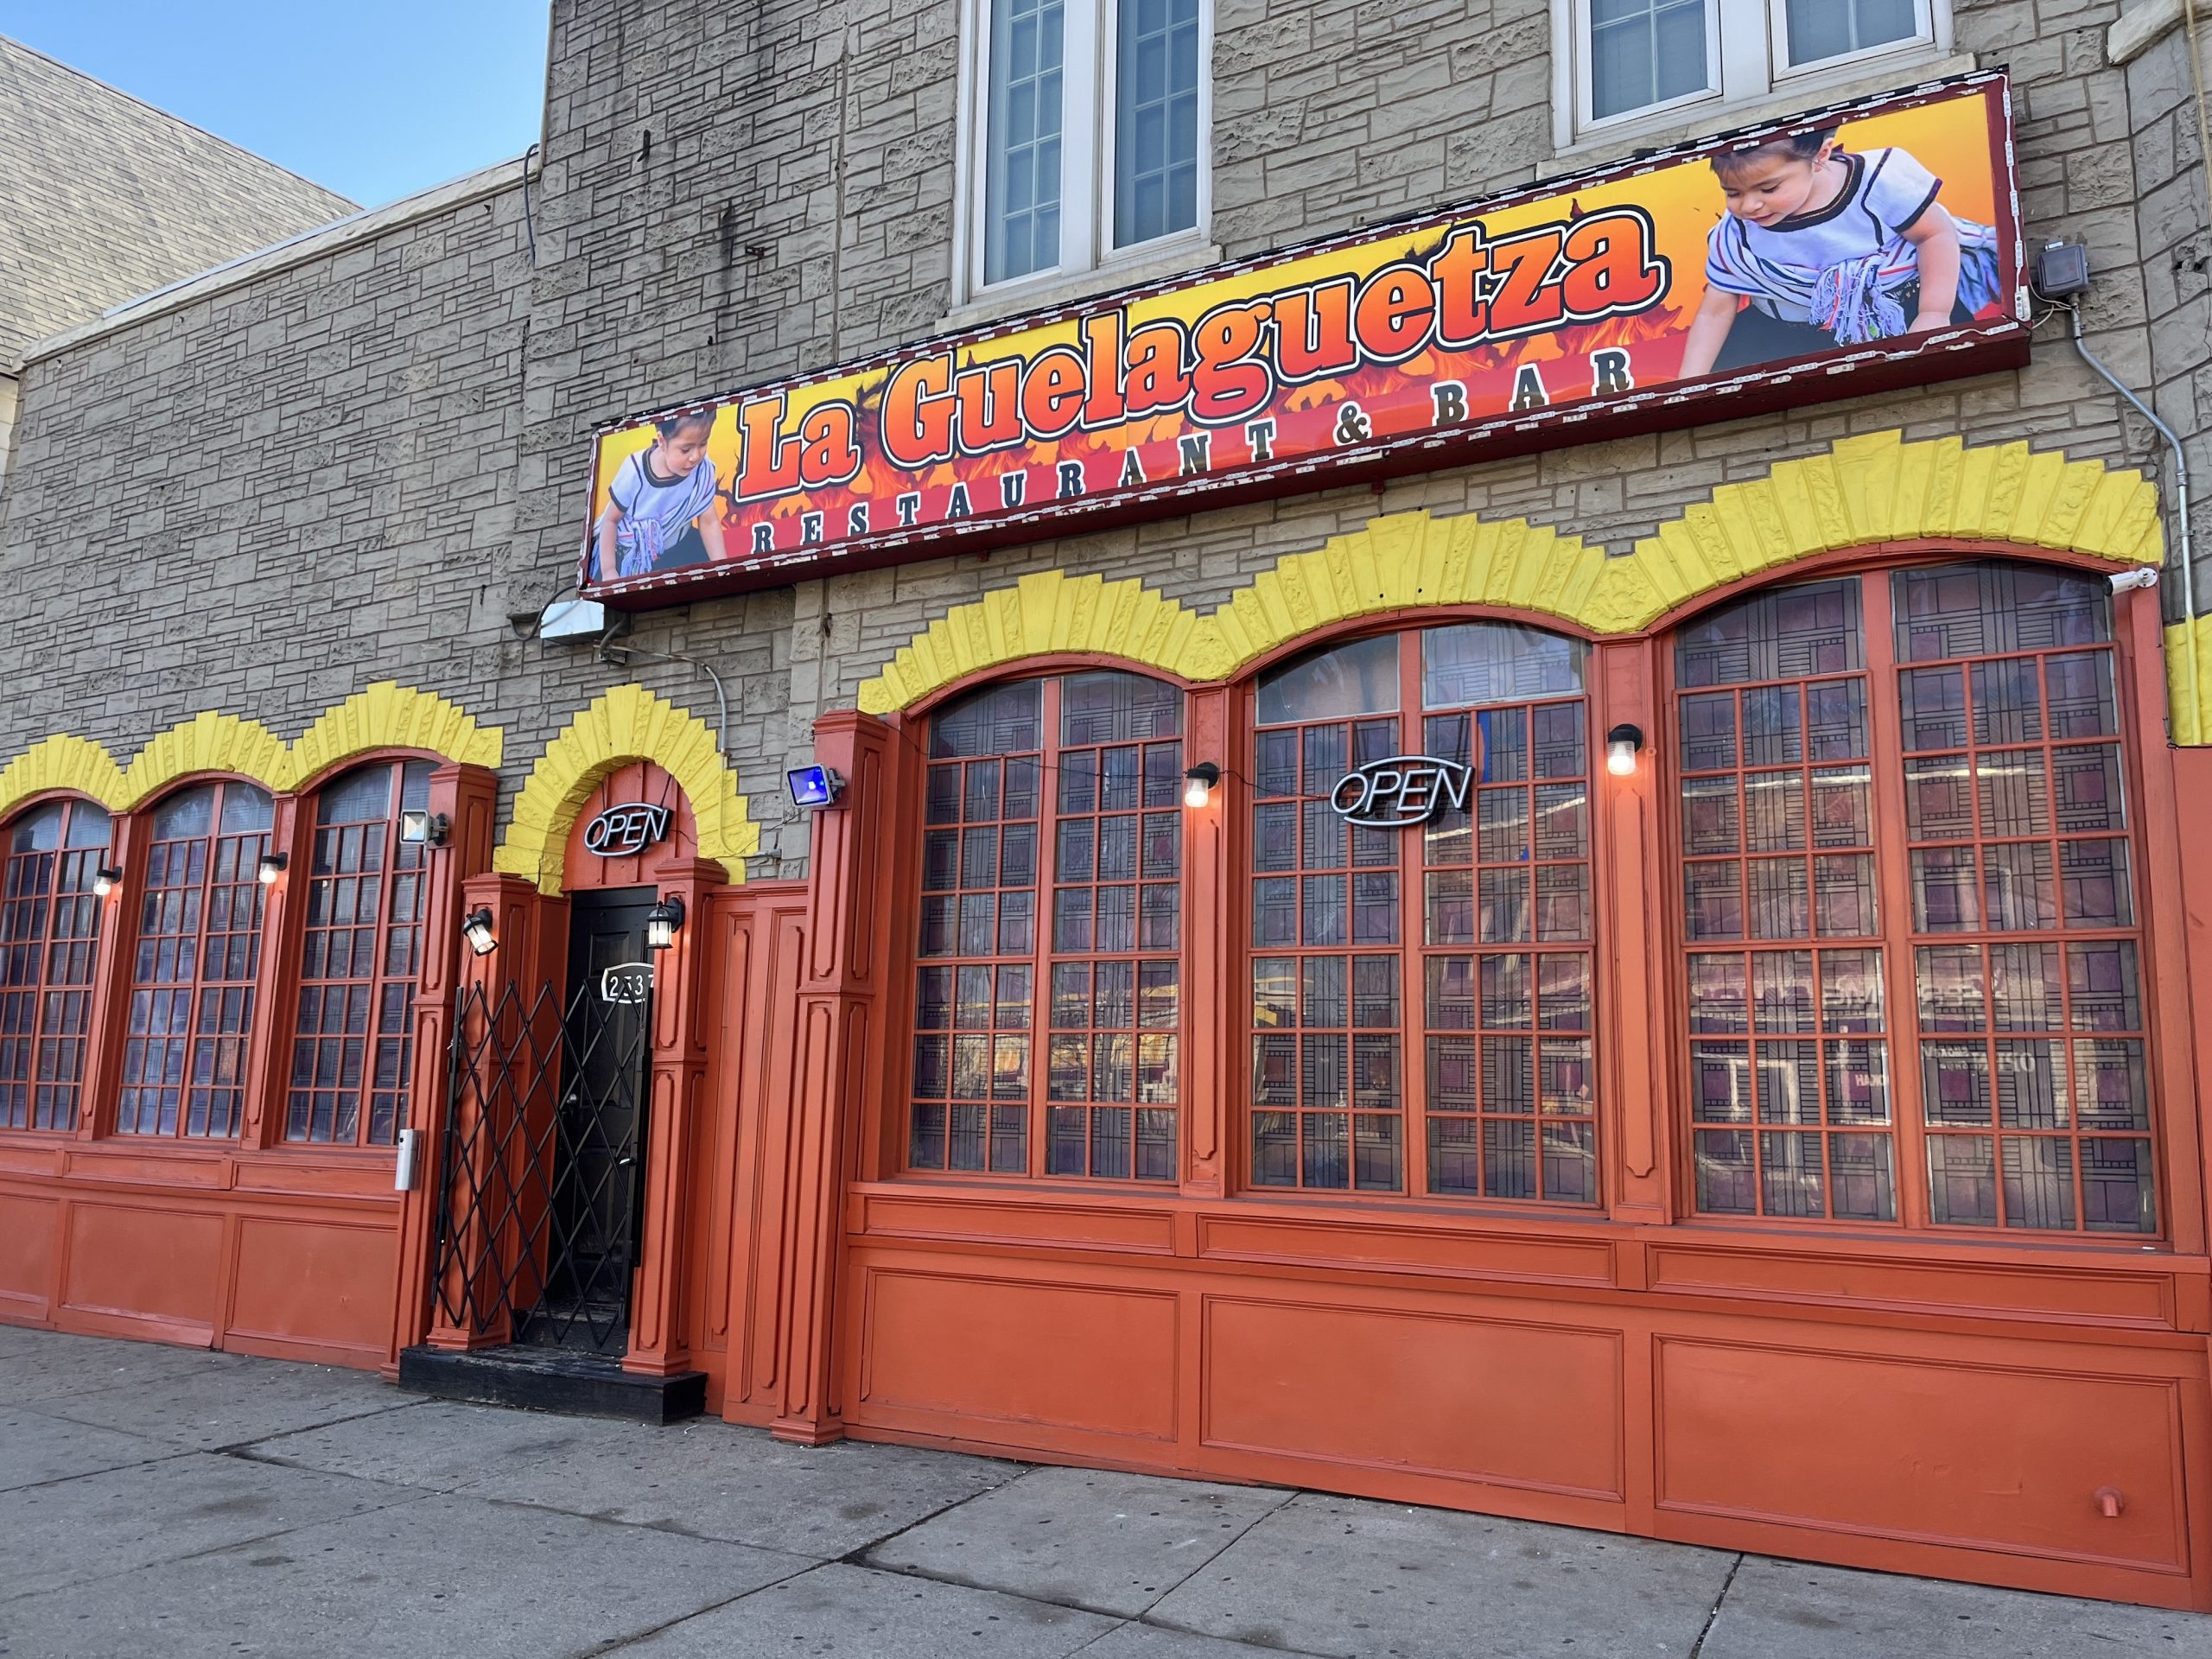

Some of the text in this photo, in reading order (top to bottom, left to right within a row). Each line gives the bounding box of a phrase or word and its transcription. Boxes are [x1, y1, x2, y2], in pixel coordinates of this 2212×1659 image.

[734, 207, 1670, 503] La Guelaguetza
[751, 346, 1633, 555] RESTAURANT & BAR
[584, 809, 668, 849] OPEN
[1331, 766, 1471, 814] OPEN
